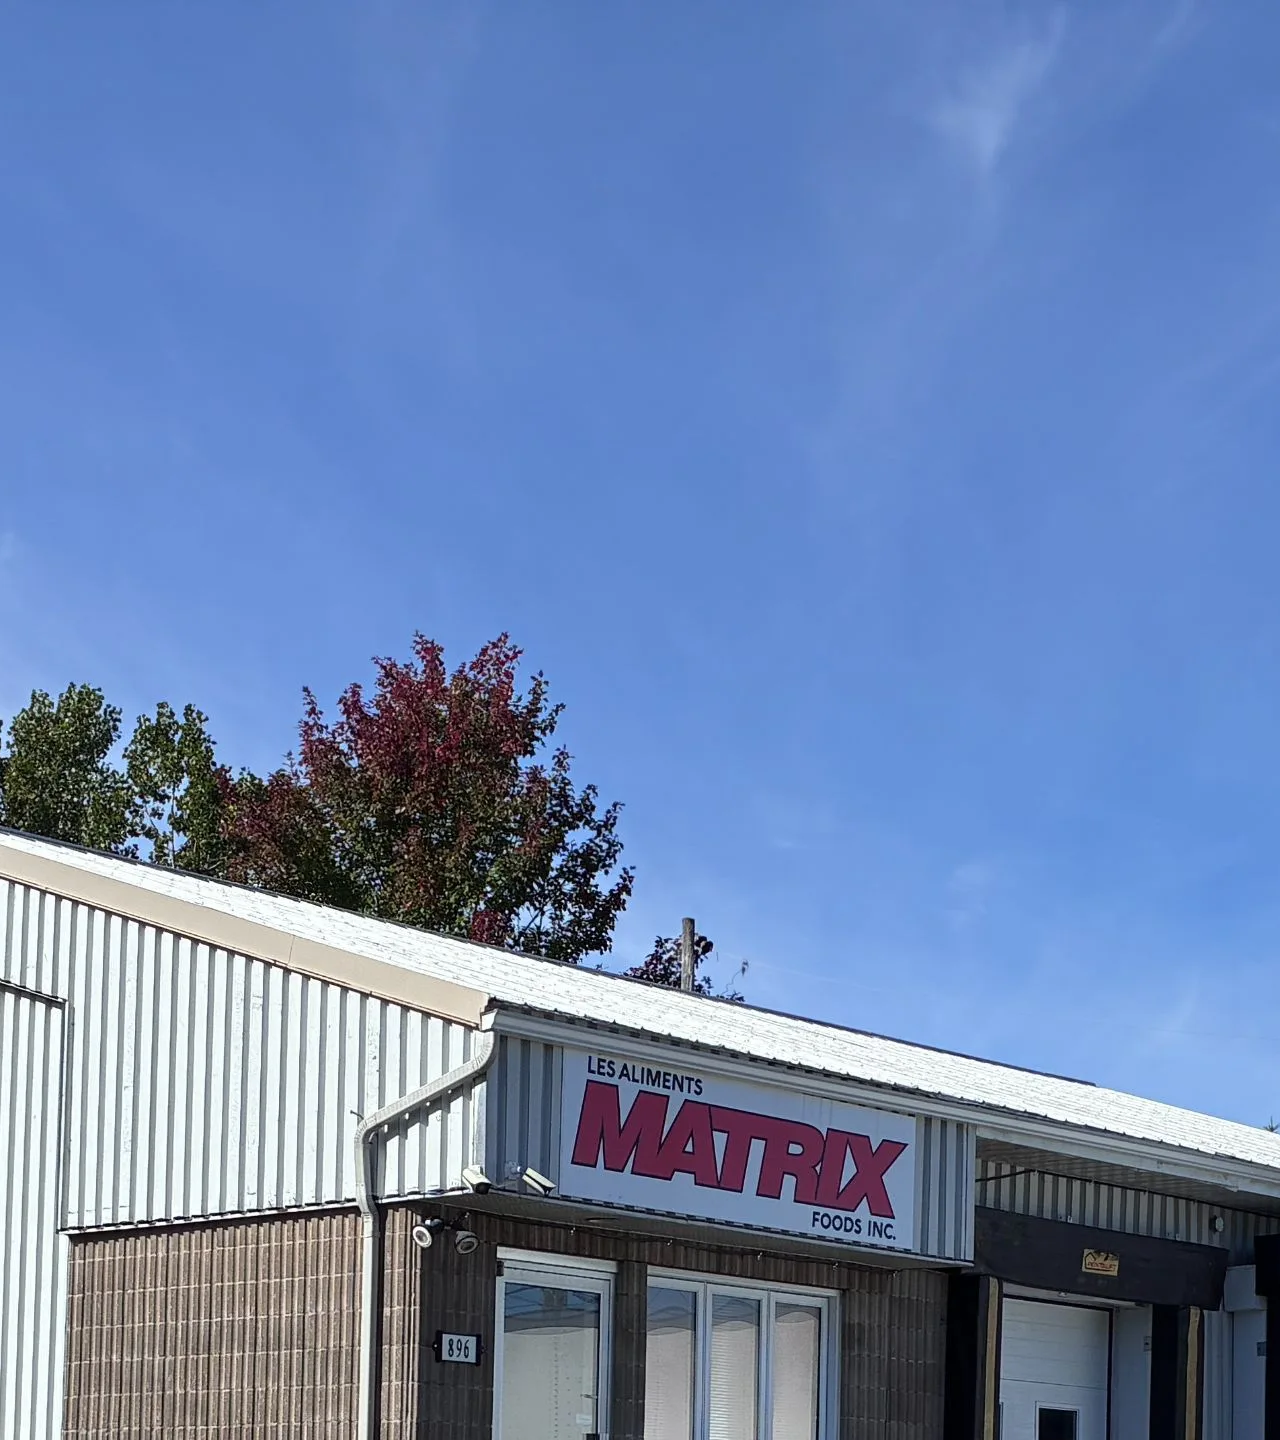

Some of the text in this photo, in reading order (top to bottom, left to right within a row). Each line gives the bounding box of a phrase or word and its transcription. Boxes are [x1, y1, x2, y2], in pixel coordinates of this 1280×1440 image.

[587, 1055, 703, 1096] LES ALIMENTS
[572, 1079, 908, 1219] MATRIX
[812, 1211, 896, 1240] FOODS INC.
[448, 1338, 470, 1359] 896
